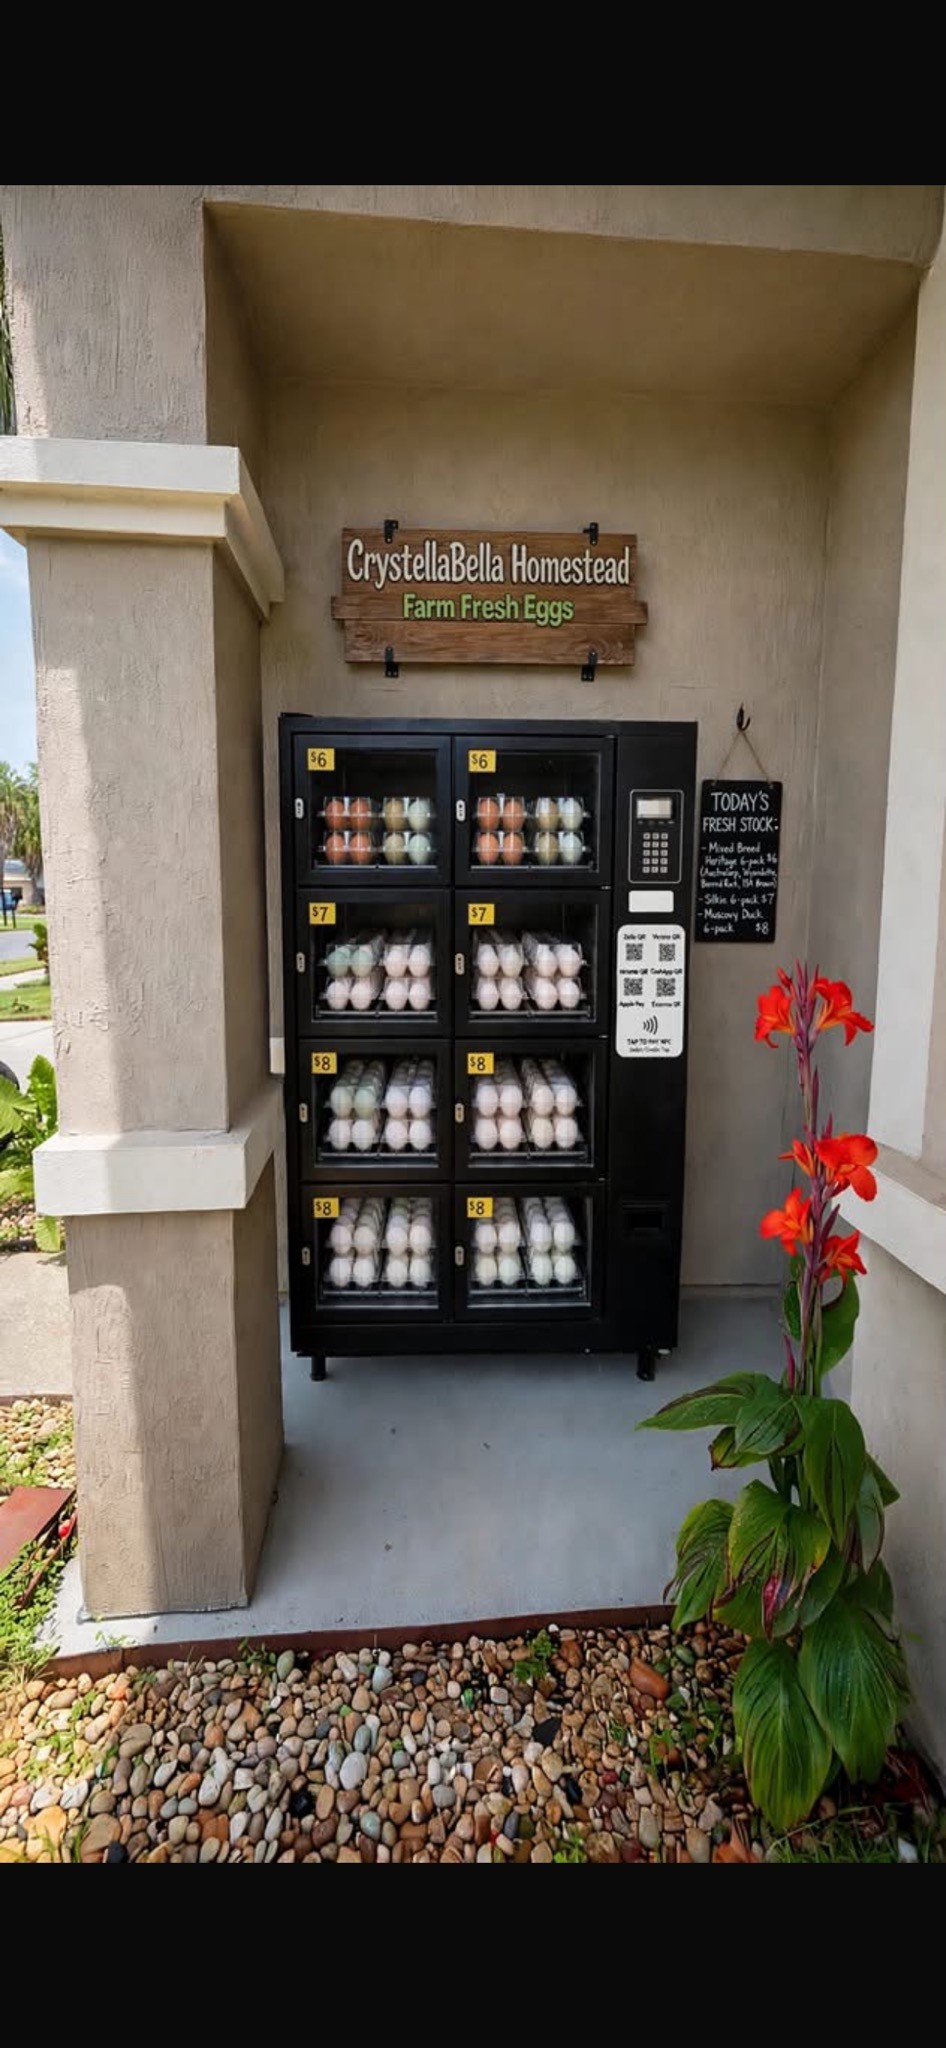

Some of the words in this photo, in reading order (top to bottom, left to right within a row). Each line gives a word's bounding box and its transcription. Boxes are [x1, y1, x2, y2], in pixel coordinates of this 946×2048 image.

[347, 538, 504, 589] CrystellaBella
[511, 543, 631, 586] Homestead
[402, 592, 455, 619] Farm
[460, 593, 519, 620] Fresh
[523, 594, 575, 627] Eggs
[310, 752, 327, 768] $6
[471, 754, 488, 769] $6
[710, 790, 770, 812] TODAY'S
[703, 817, 736, 832] FRESH
[740, 817, 779, 832] STOCK:
[709, 842, 734, 853] Mixed
[737, 842, 761, 853] Breed
[740, 856, 765, 869] 6-pack
[730, 894, 760, 907] 6-pack
[761, 893, 775, 905] $7
[312, 907, 329, 921] $7
[471, 907, 487, 921] $7
[704, 908, 739, 922] Muscovy
[742, 908, 764, 919] Duck
[703, 922, 735, 935] 6-pack
[755, 921, 769, 935] $8
[313, 1056, 330, 1071] $8
[470, 1056, 486, 1071] $8
[315, 1201, 331, 1216] $8
[469, 1201, 485, 1216] $8
